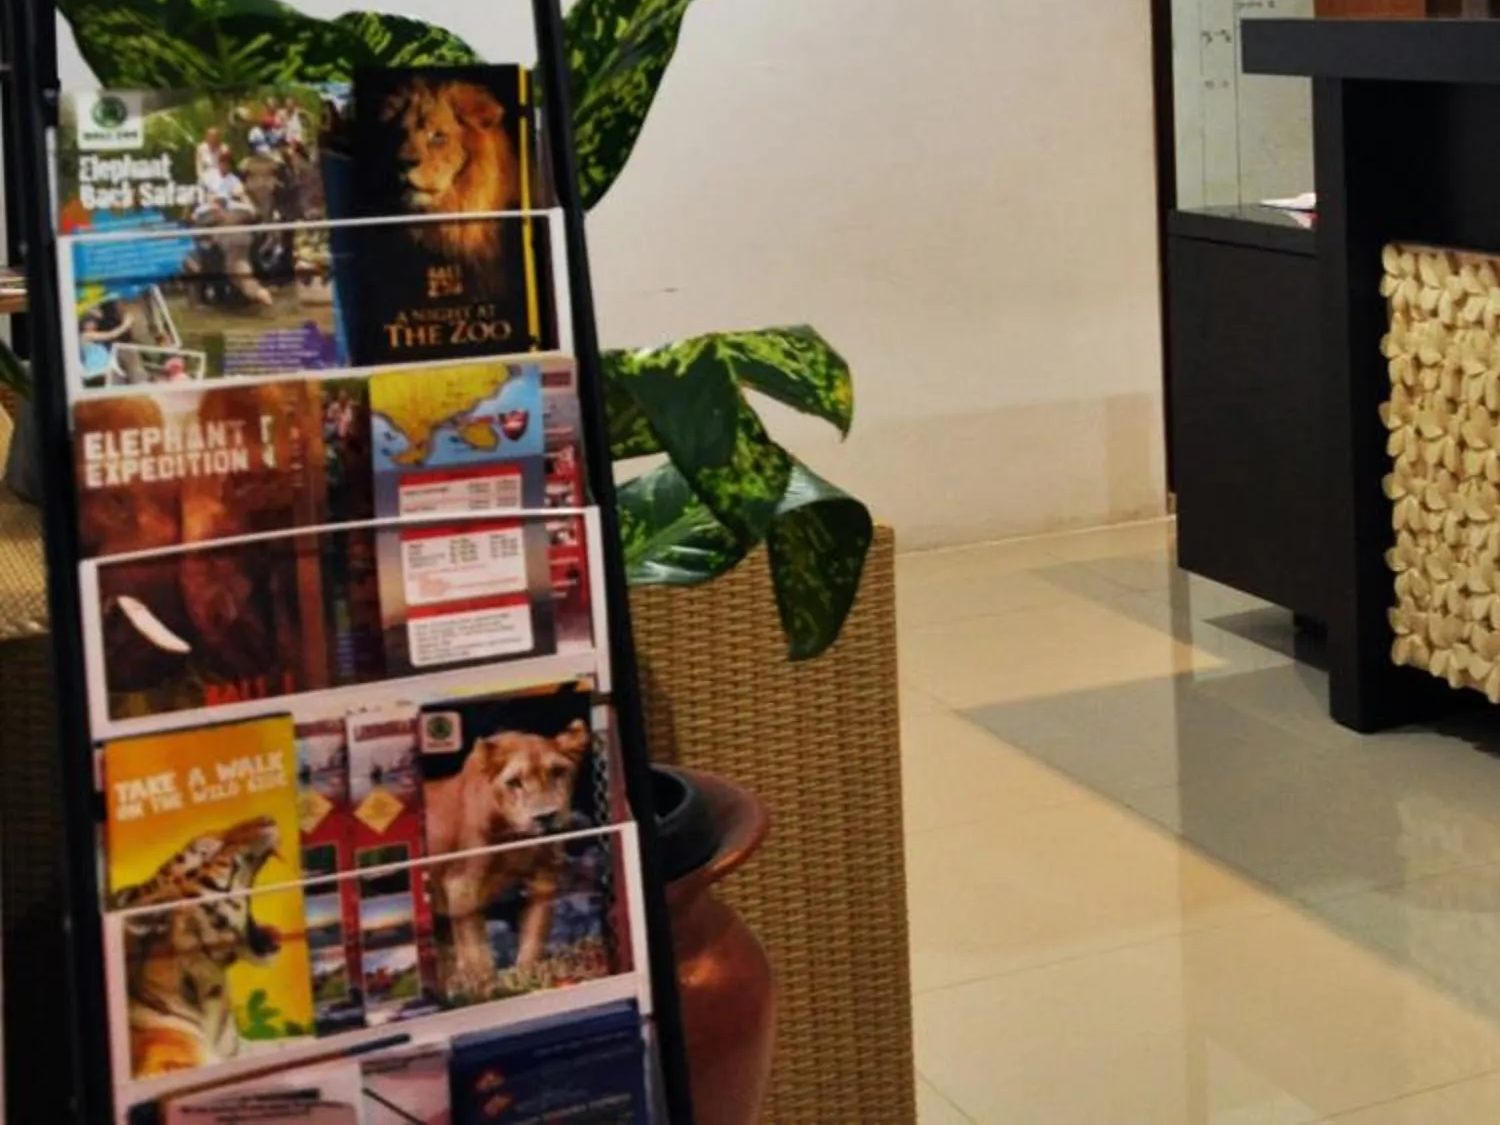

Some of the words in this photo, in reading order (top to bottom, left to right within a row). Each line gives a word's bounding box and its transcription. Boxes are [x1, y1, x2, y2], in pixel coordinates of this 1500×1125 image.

[78, 152, 173, 185] Elephant
[384, 322, 443, 348] THE
[449, 320, 513, 344] ZOO
[83, 419, 246, 460] ELEPHANT
[85, 448, 250, 488] EXPEDITION
[114, 771, 177, 804] TAKE
[188, 766, 206, 786] A
[215, 750, 283, 780] WALK
